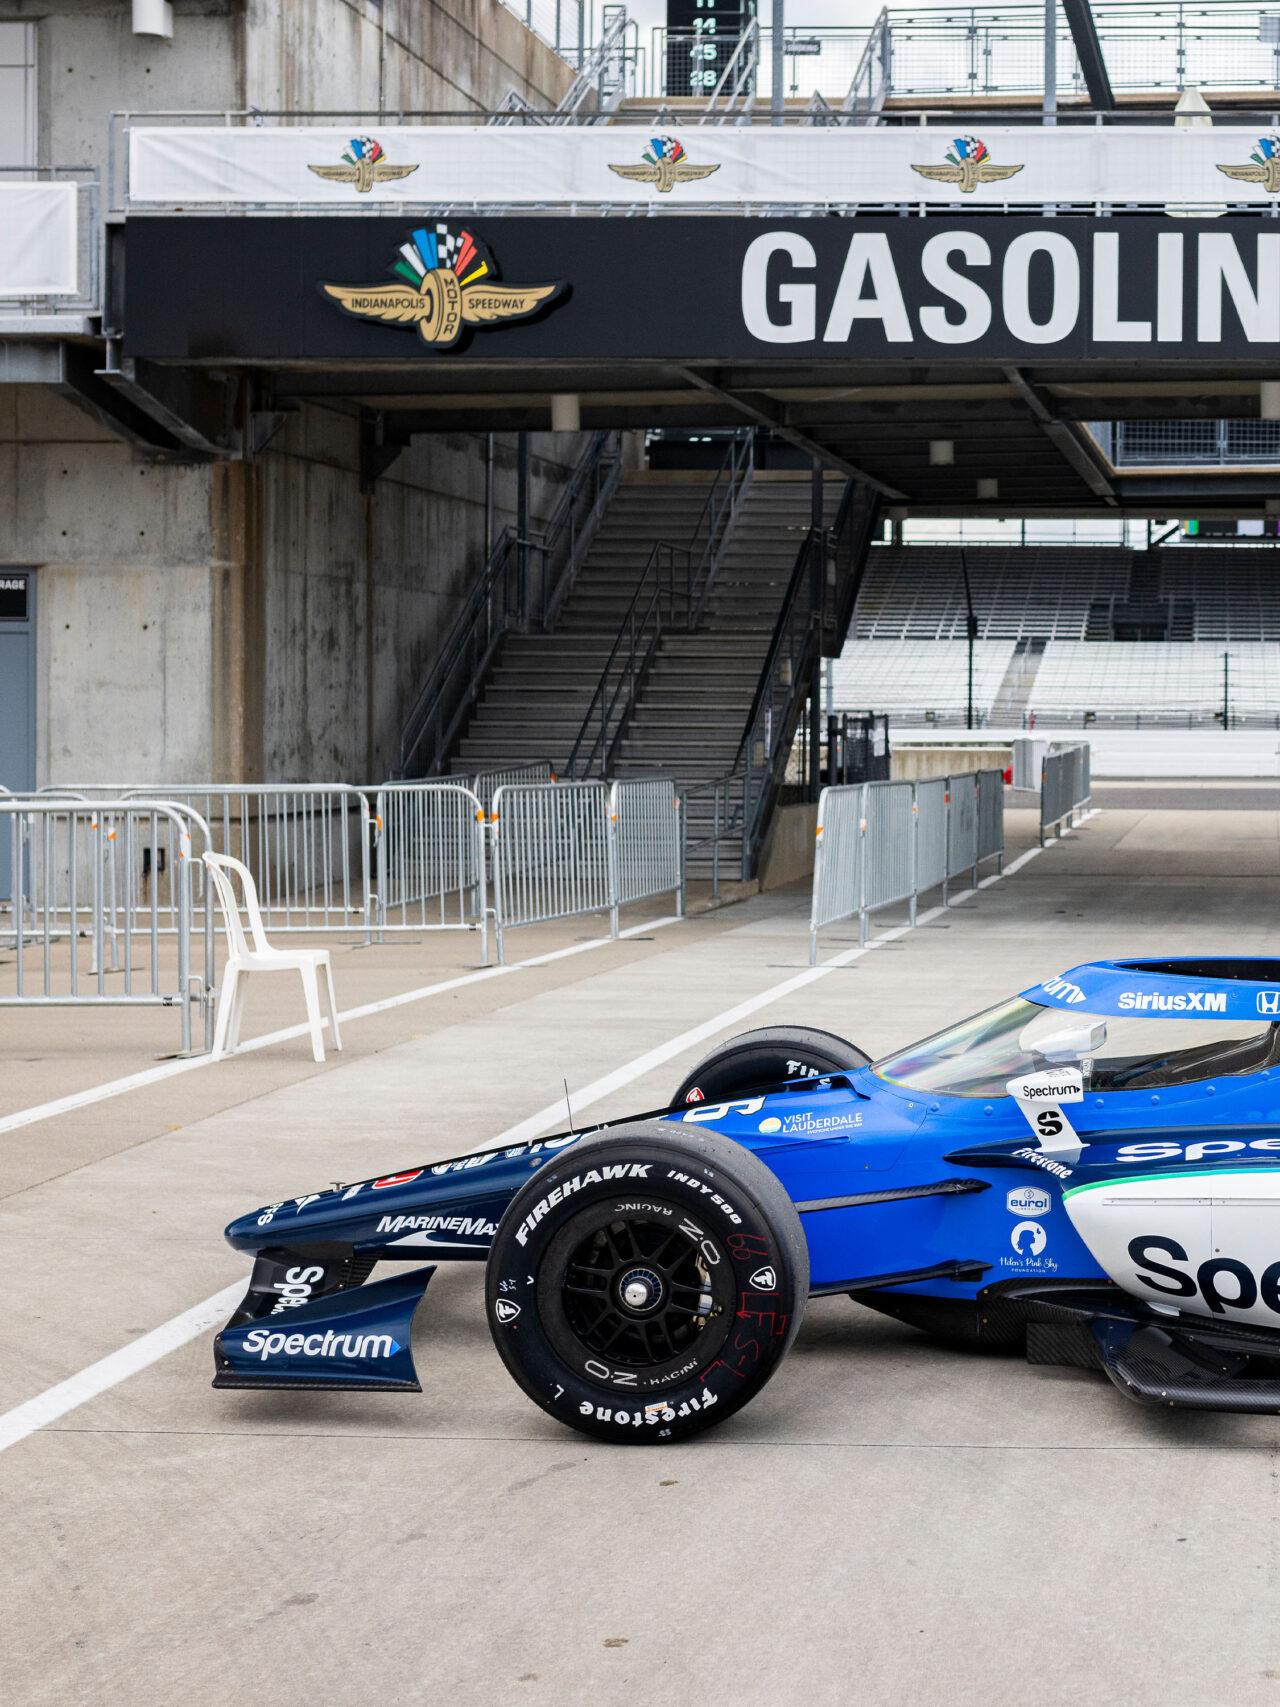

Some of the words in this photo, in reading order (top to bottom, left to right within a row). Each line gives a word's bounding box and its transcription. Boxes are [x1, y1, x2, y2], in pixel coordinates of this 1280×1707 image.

[351, 298, 425, 309] INDIANAPOLIS
[443, 278, 458, 334] MOTOR
[468, 298, 525, 309] SPEEDWAY
[1117, 992, 1226, 1012] SiriusXM
[1023, 1084, 1076, 1099] Spectrum
[783, 1112, 863, 1133] LAUDERDALE
[784, 1112, 813, 1124] VISIT
[1012, 1147, 1073, 1179] Firestone
[515, 1163, 653, 1247] FIREHAWK
[1010, 1198, 1048, 1208] eurol
[1000, 1257, 1023, 1267] Helen's
[1026, 1257, 1042, 1267] Pink
[1043, 1258, 1058, 1272] Sky
[242, 1330, 393, 1361] Spectrum
[579, 1387, 718, 1427] Firestone
